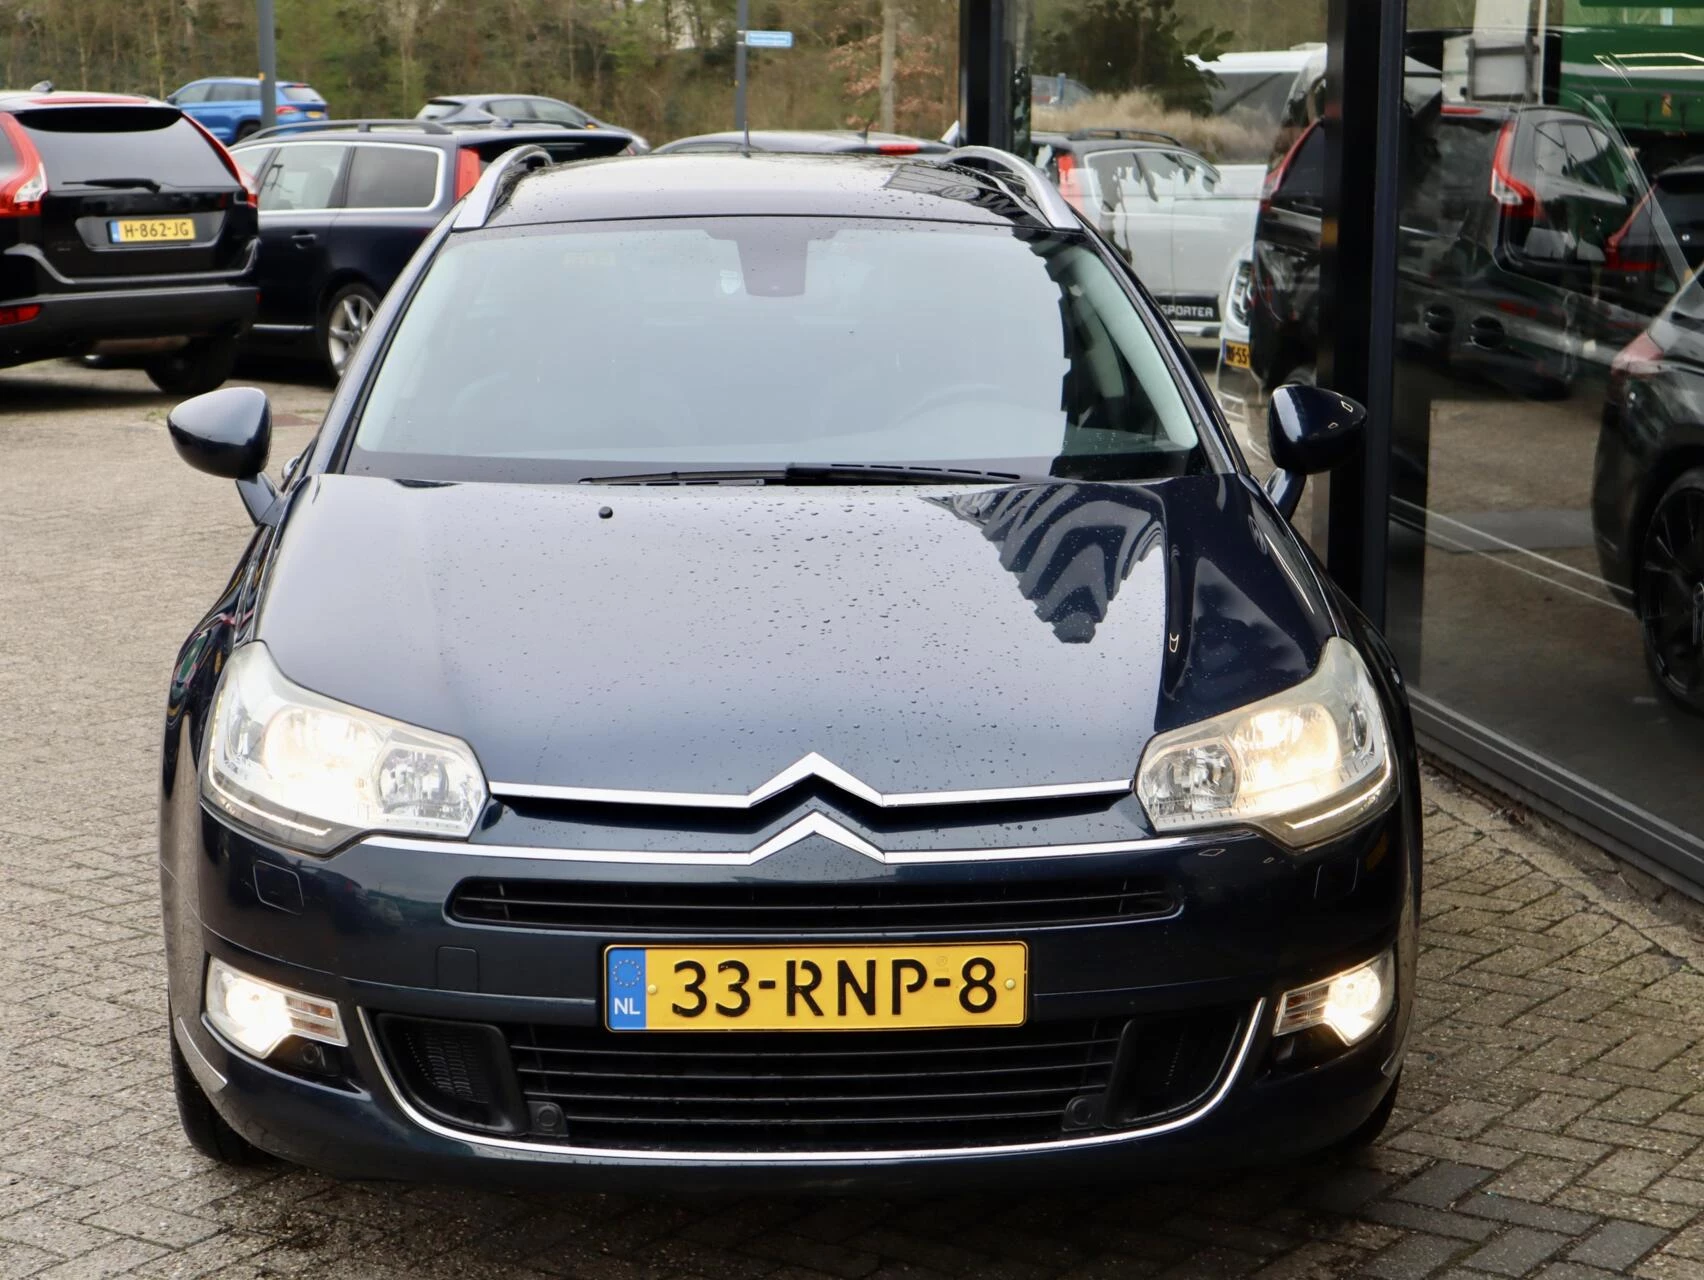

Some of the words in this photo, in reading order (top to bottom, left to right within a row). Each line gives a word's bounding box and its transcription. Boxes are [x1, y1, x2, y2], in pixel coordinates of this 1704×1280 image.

[124, 222, 189, 238] H-862-JG
[671, 957, 998, 1017] 33-RNP-8
[613, 997, 641, 1016] NL
